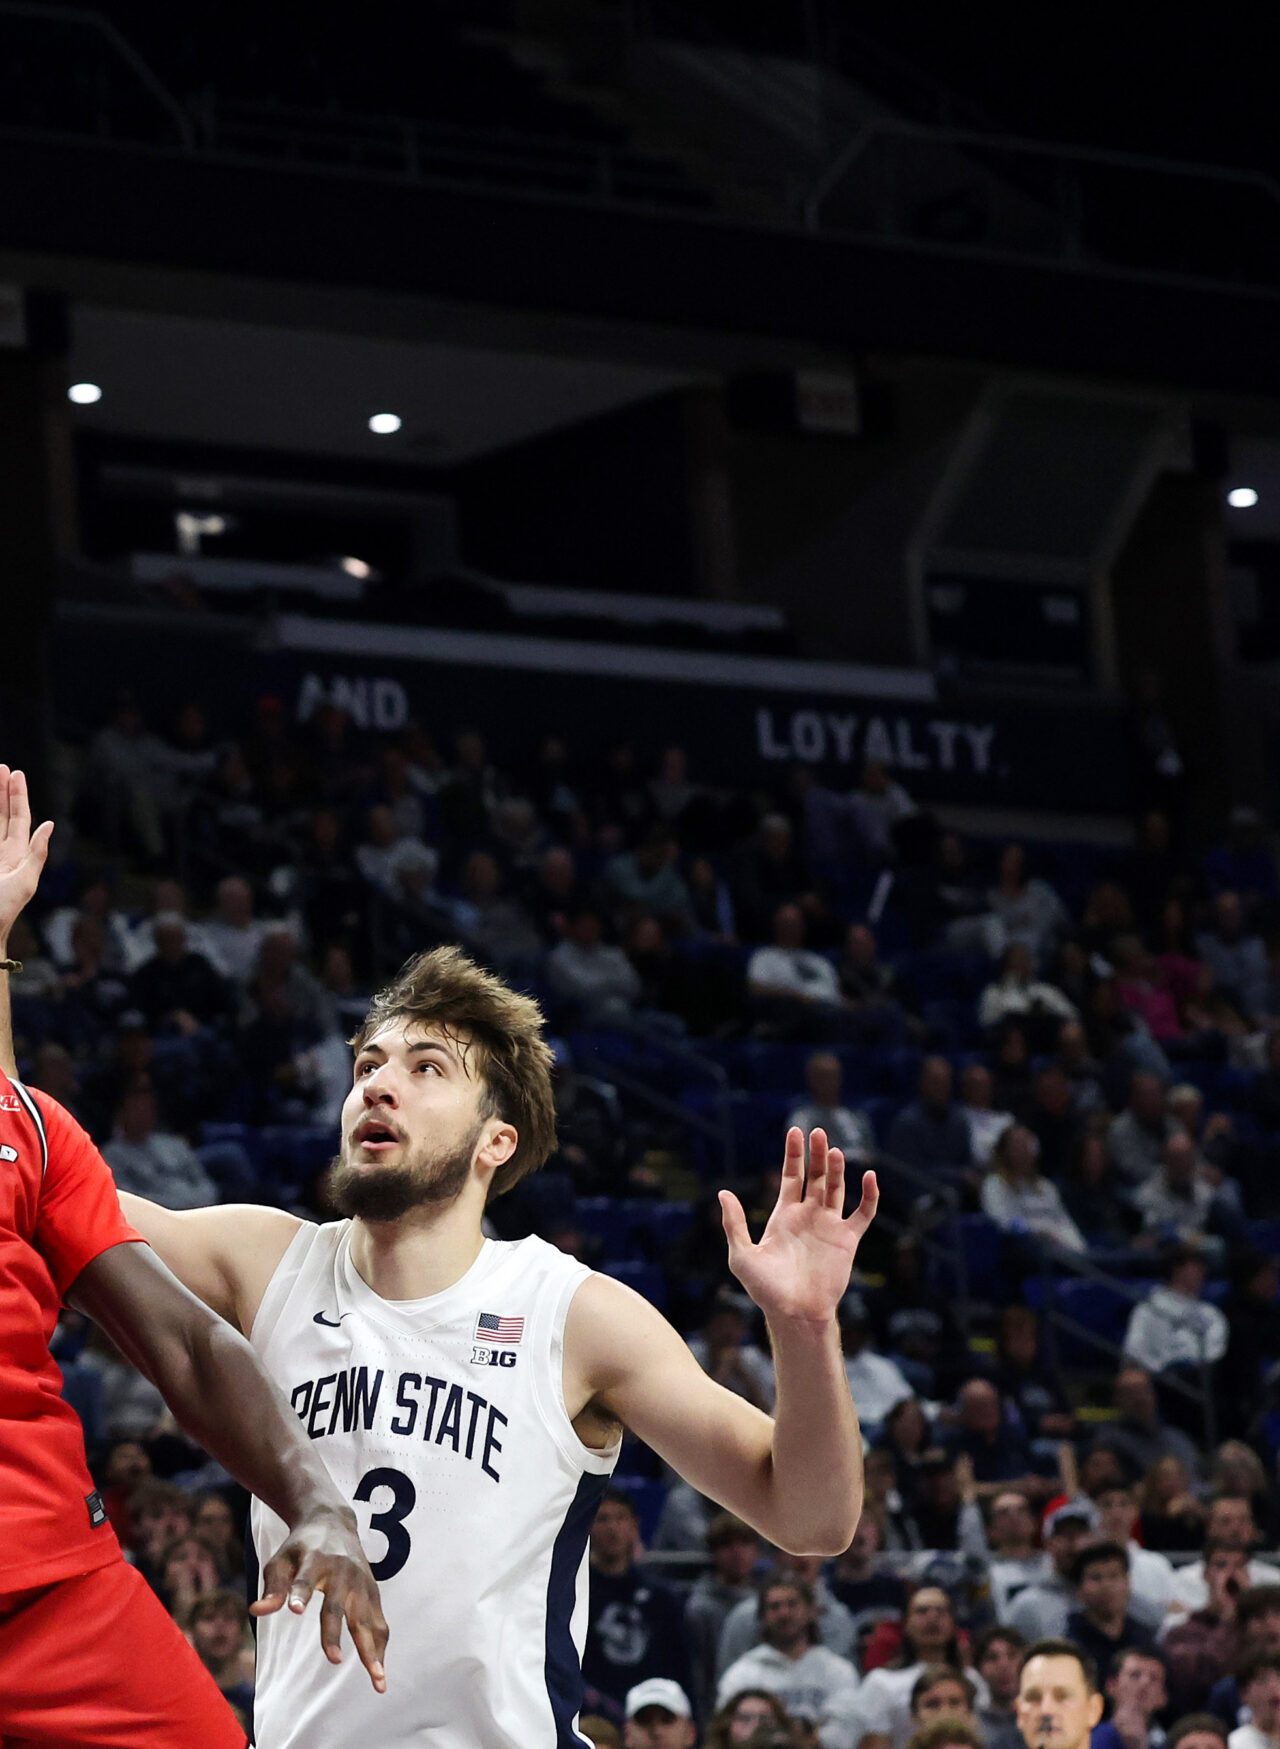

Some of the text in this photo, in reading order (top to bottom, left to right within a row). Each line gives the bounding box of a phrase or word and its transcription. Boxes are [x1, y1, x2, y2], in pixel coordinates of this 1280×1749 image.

[297, 672, 409, 730] AND
[290, 1366, 509, 1483] PENN STATE
[353, 1467, 417, 1582] 3
